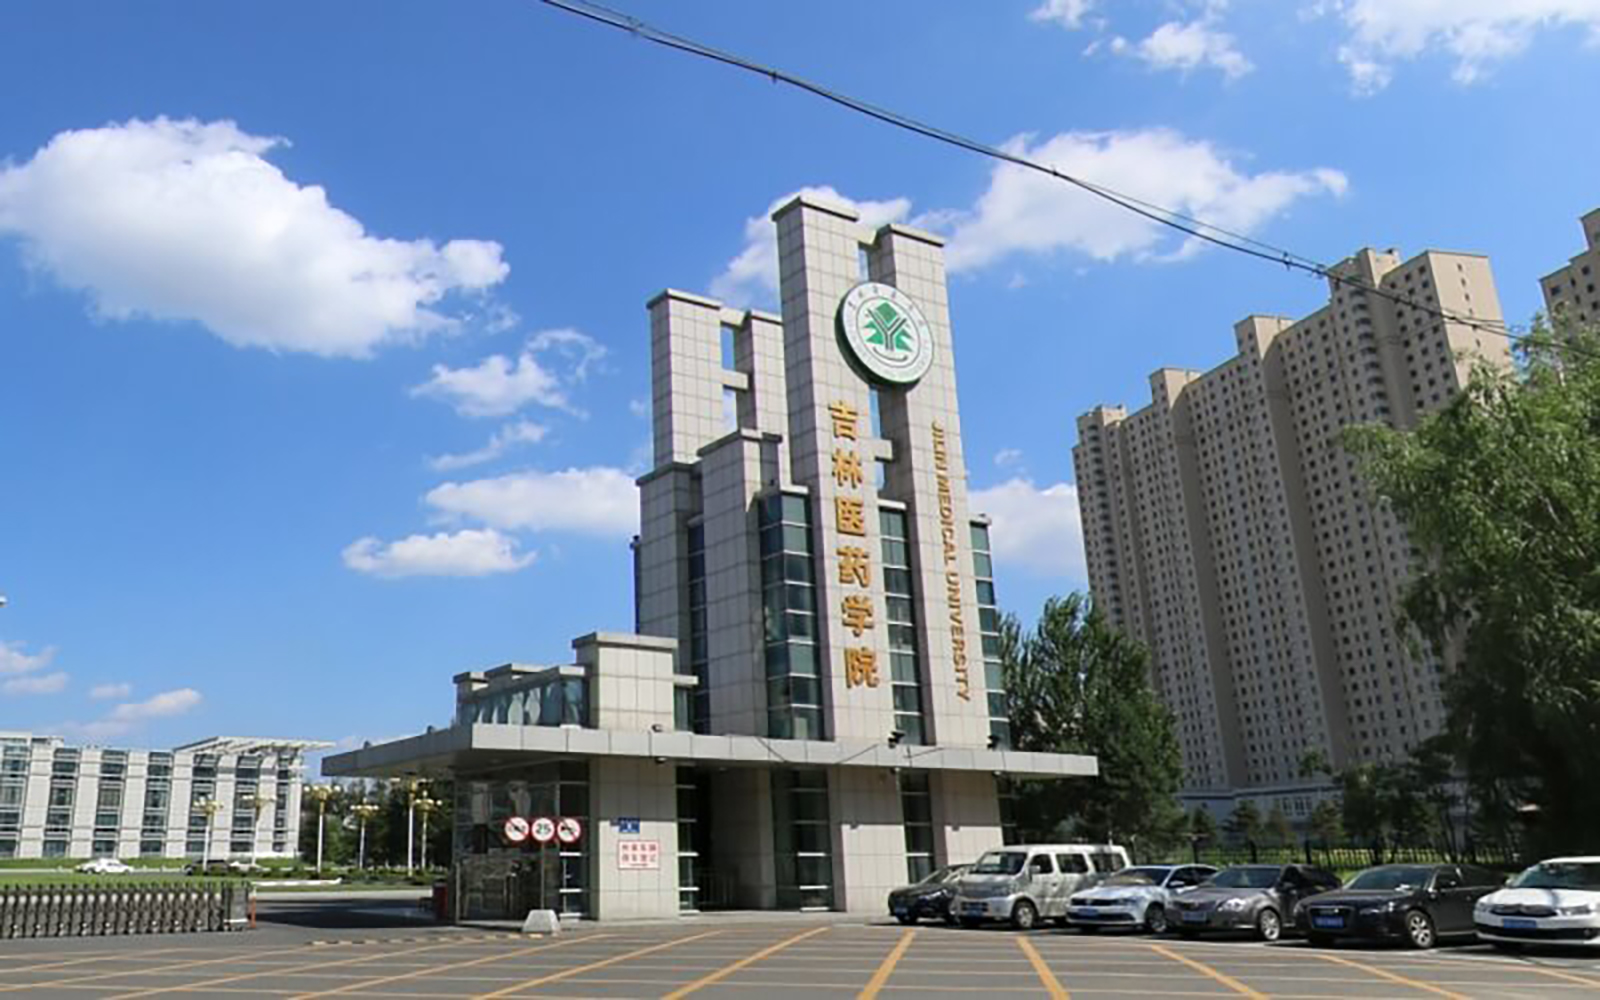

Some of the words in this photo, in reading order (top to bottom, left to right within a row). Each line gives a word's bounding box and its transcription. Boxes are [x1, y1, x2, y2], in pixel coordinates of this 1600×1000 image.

[931, 419, 948, 472] JILIN
[828, 400, 879, 689] 吉林医药学院
[936, 473, 956, 566] MEDICAL
[945, 572, 970, 702] UNIVERSITY
